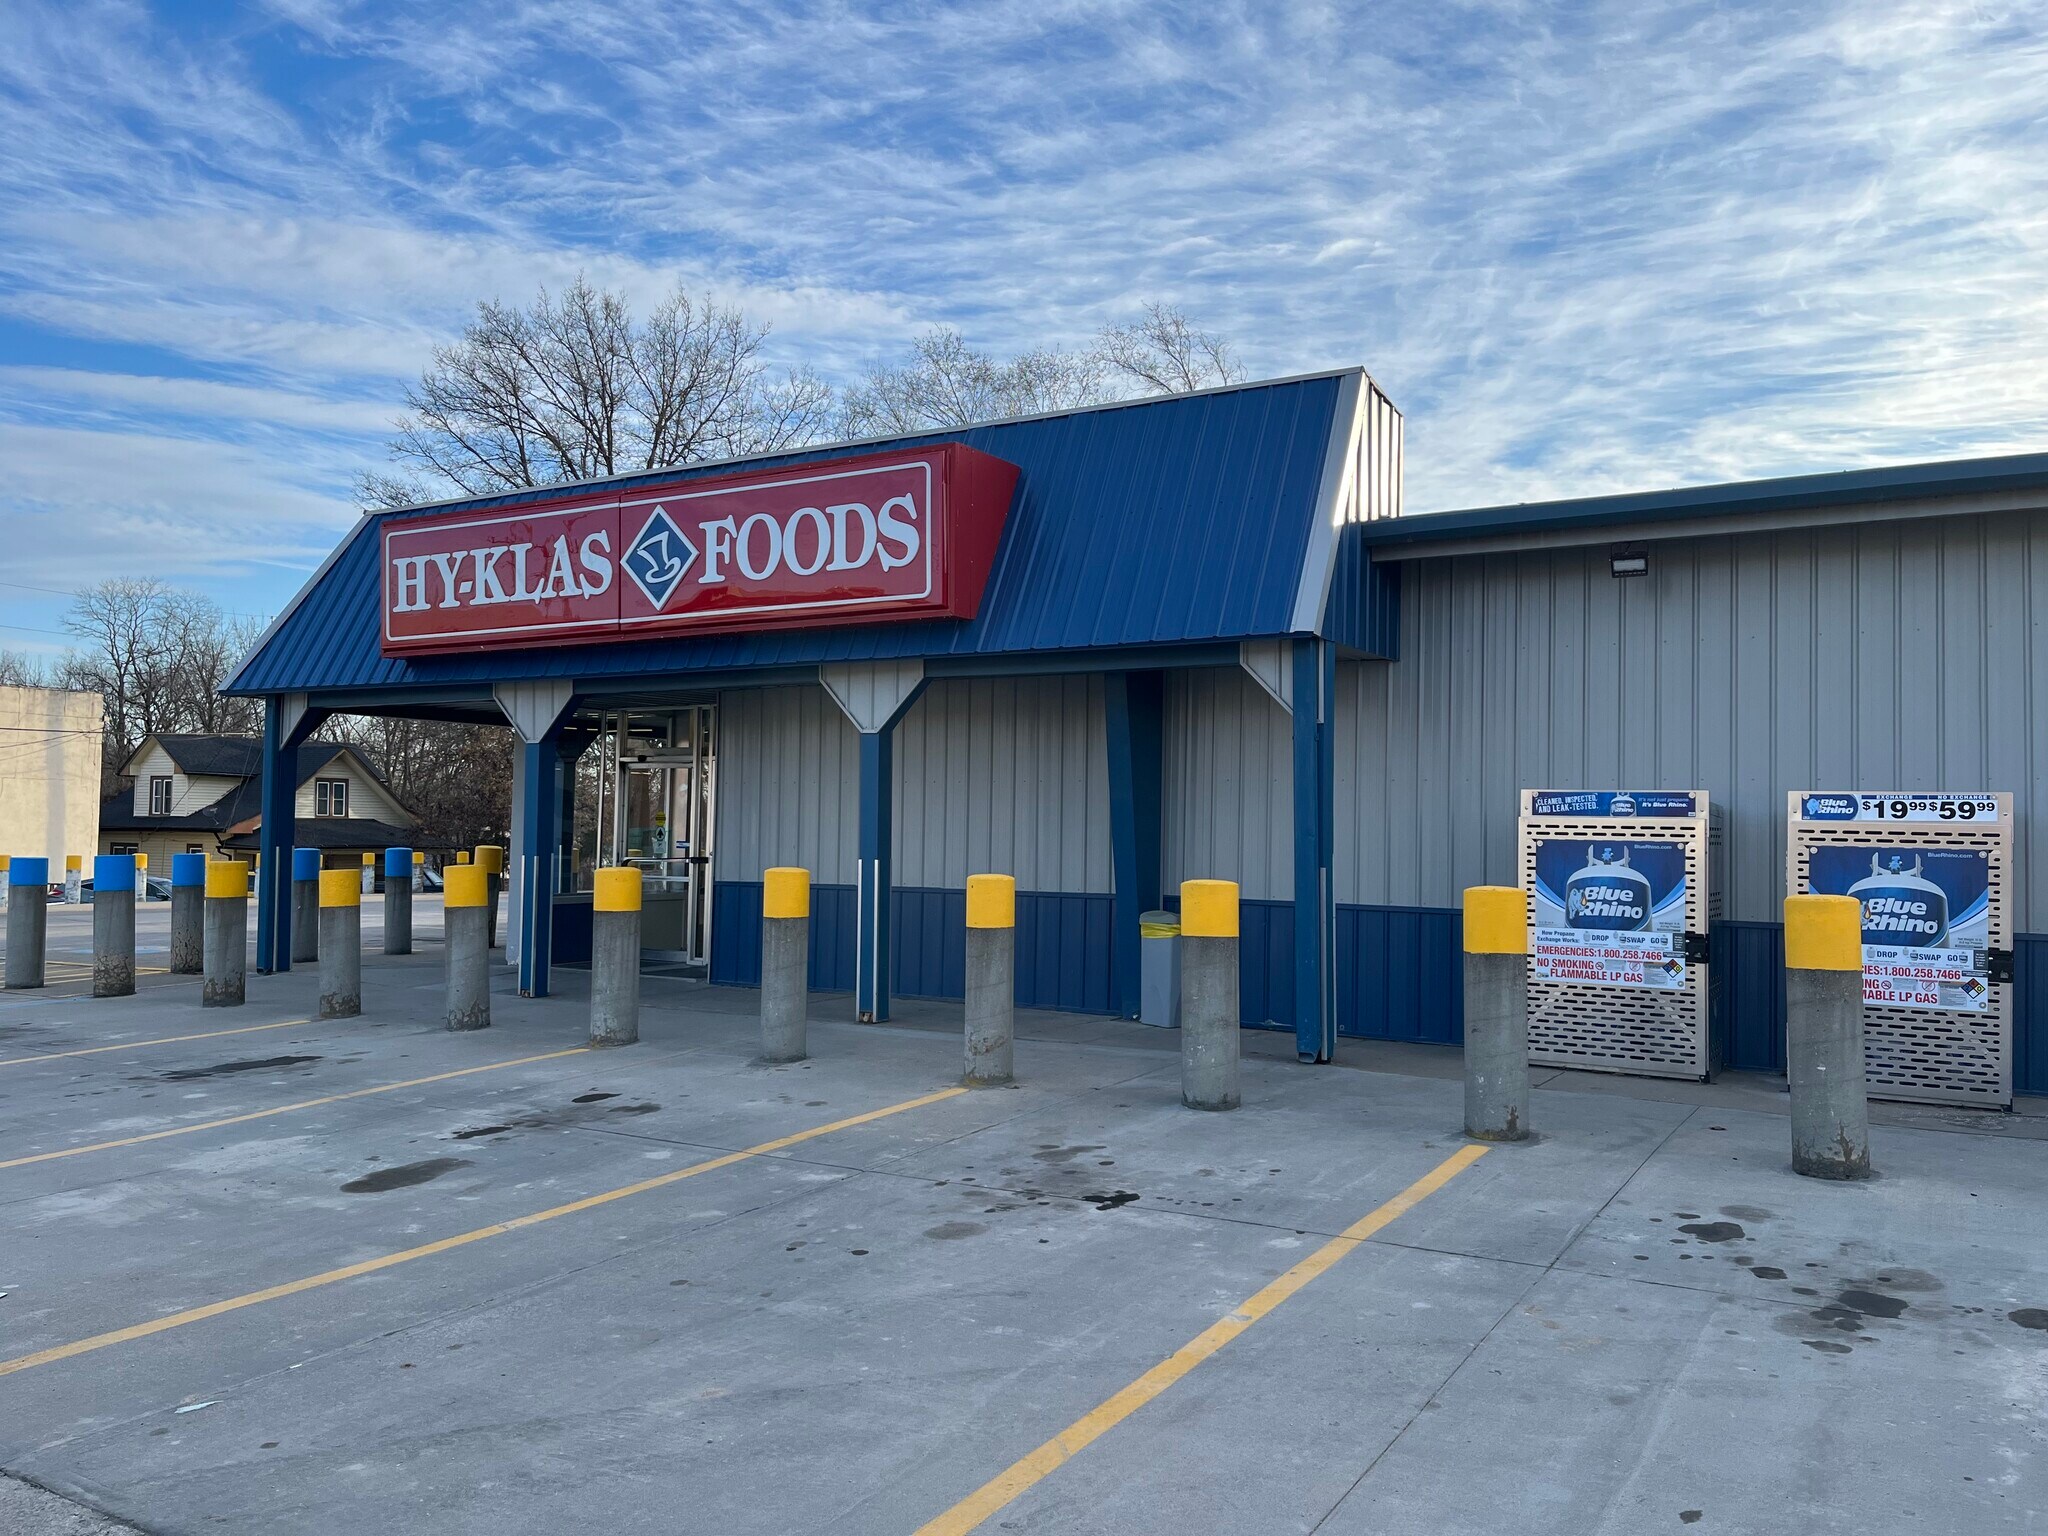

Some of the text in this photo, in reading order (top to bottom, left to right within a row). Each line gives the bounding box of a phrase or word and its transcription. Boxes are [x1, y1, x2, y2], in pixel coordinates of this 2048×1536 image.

[392, 493, 920, 614] HY-KLAS FOODS
[1820, 798, 1848, 807] Blue
[1538, 805, 1551, 814] AND
[1817, 805, 1854, 814] Rhino
[1585, 886, 1634, 902] Blue
[1579, 901, 1643, 919] Rhino
[1868, 897, 1927, 915] Blue
[1862, 914, 1939, 934] Rhino
[1536, 936, 1561, 944] Exchange
[1555, 931, 1576, 939] Propane
[1591, 934, 1610, 942] DROP
[1626, 936, 1646, 944] SWAP
[1918, 953, 1942, 961] SWAP
[1537, 958, 1550, 967] NO
[1551, 959, 1595, 970] SMOKING
[1550, 969, 1608, 981] FLAMMABLE
[1610, 972, 1622, 981] LP
[1623, 973, 1643, 983] GAS
[1899, 992, 1913, 1002] LP
[1915, 992, 1938, 1004] GAS
